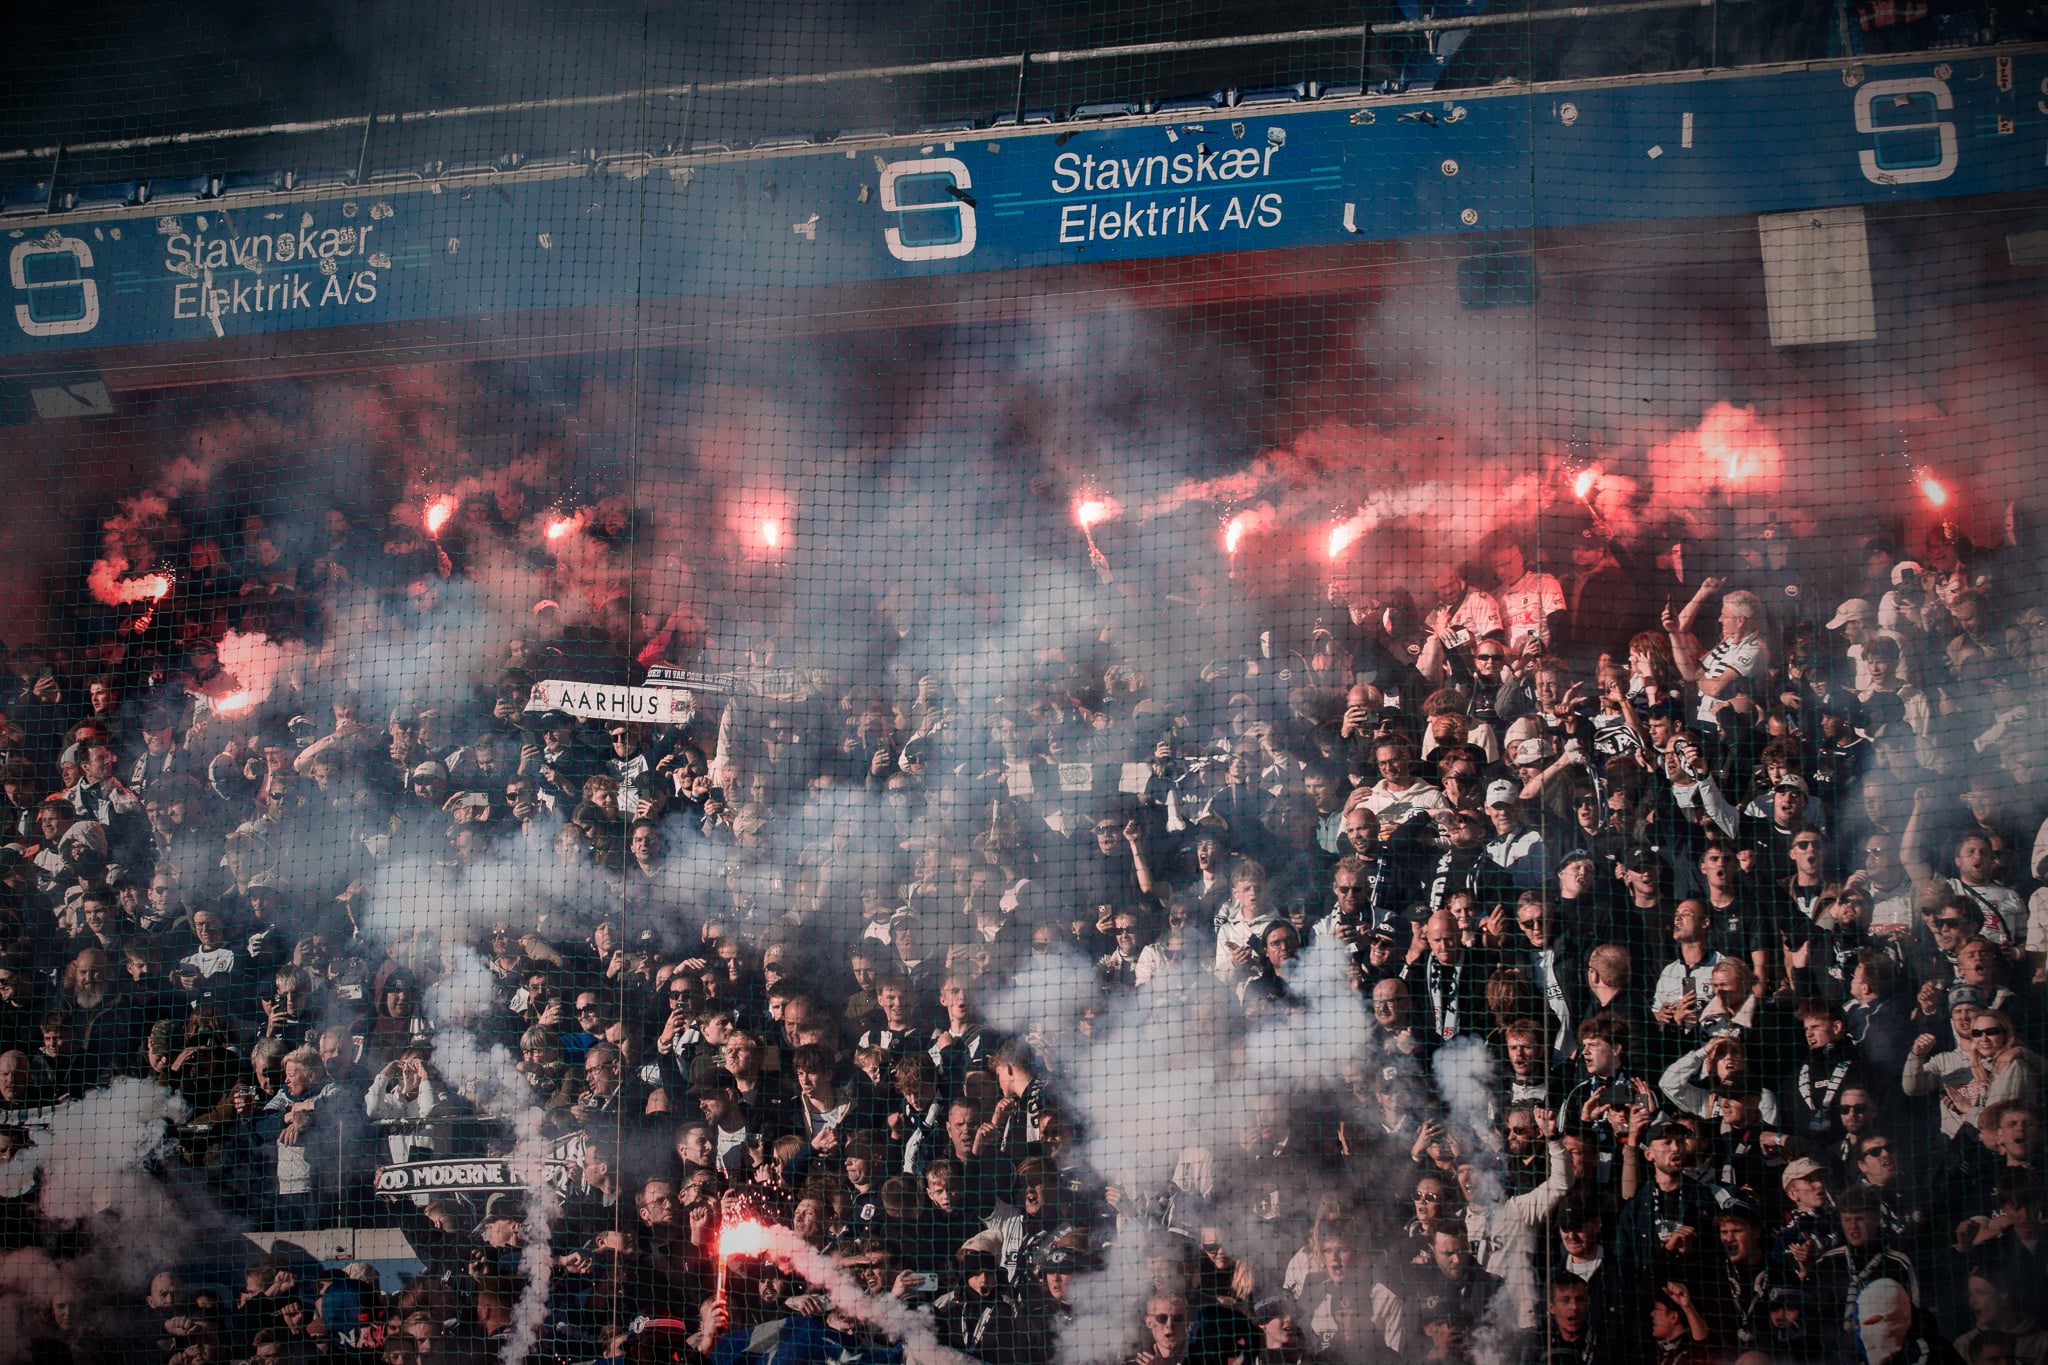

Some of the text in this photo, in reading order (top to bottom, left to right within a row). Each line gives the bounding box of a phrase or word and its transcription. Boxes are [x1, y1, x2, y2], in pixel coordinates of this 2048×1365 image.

[1051, 145, 1279, 194] Stavnskær
[1059, 193, 1283, 243] Elektrik A/S
[320, 271, 377, 306] A/S
[560, 689, 658, 715] AARHUS
[378, 1170, 408, 1190] OD
[413, 1163, 504, 1187] MODERNE
